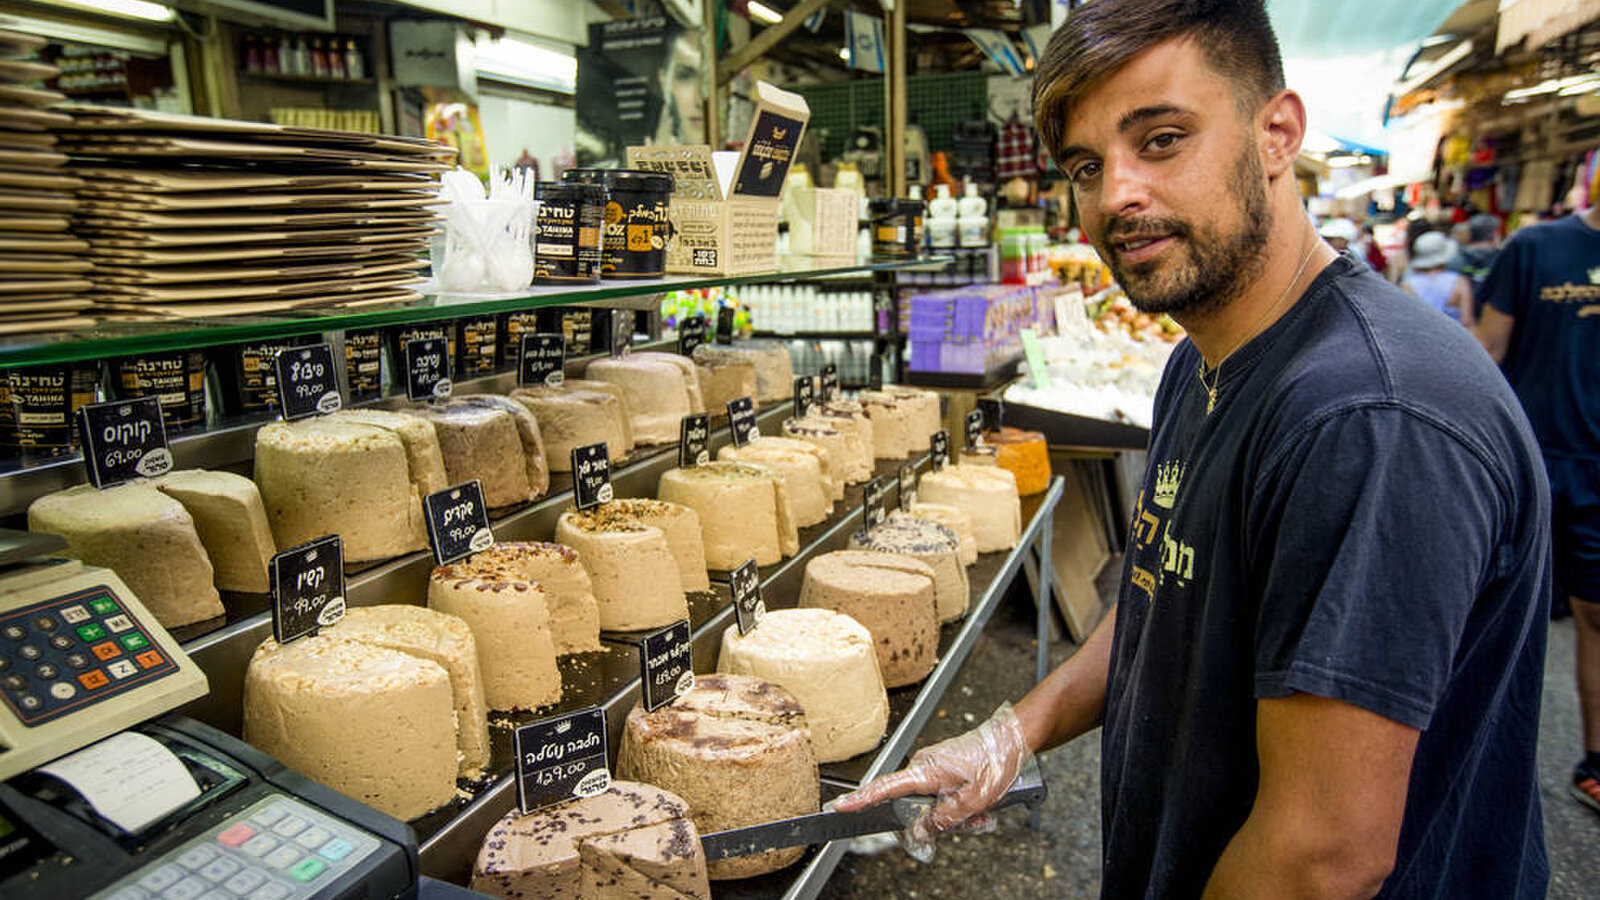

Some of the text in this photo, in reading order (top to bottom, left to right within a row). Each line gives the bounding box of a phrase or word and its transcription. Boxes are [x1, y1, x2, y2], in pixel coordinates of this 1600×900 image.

[137, 358, 183, 373] טחינה
[9, 372, 65, 388] טחינה
[25, 394, 65, 404] TAHINA
[296, 384, 324, 398] 99.00
[103, 420, 151, 446] קוקוס
[105, 448, 143, 468] 69.00
[443, 501, 474, 527] שקדים
[449, 524, 476, 542] 99.00
[297, 566, 325, 591] קשיו
[294, 594, 327, 617] 99.00
[525, 731, 600, 765] חלבה נוטלה
[536, 761, 586, 786] 129.00
